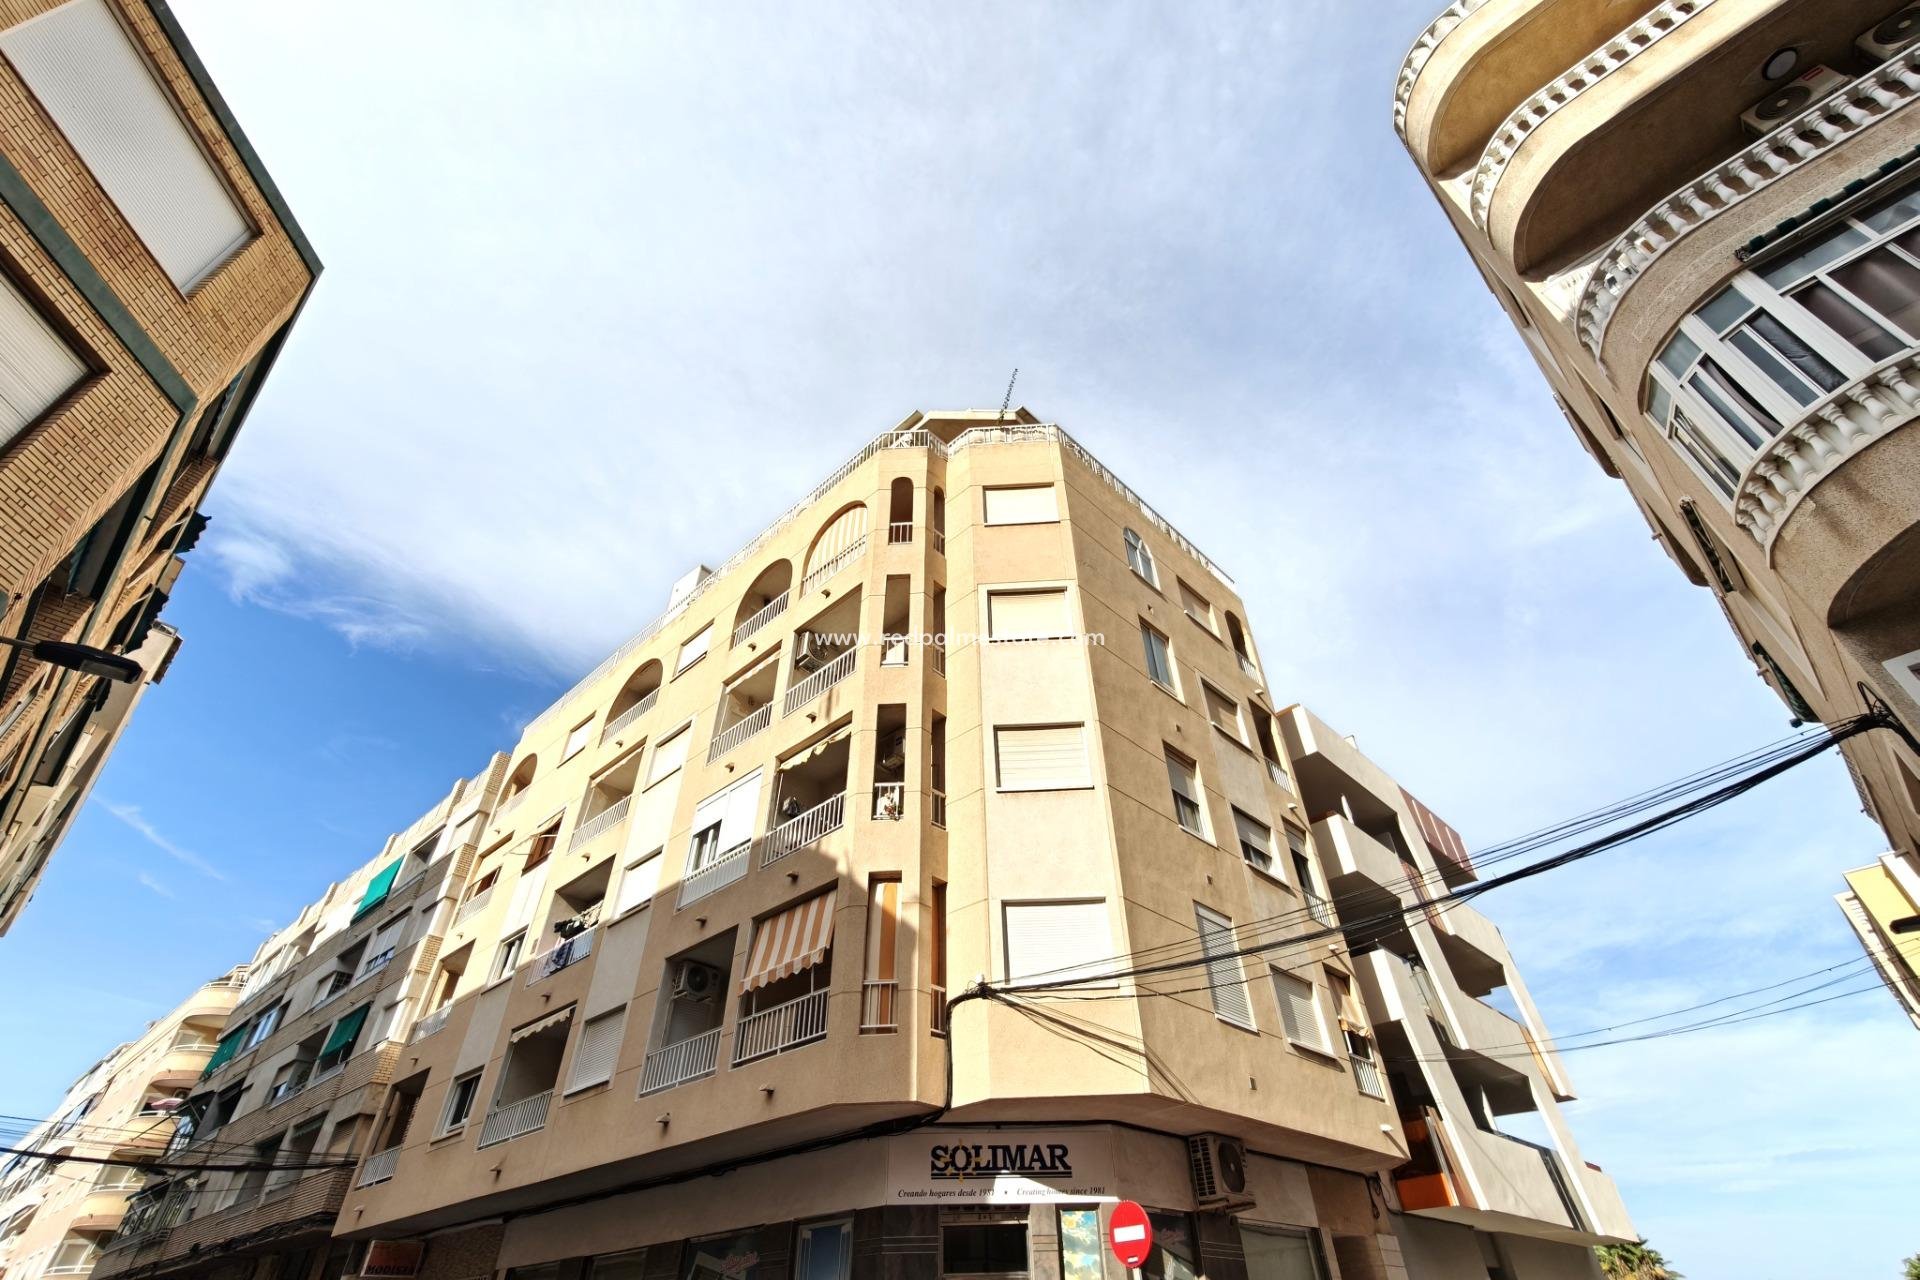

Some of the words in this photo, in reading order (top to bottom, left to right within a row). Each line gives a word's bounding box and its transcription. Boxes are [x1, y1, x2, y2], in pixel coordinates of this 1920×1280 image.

[931, 1143, 1072, 1172] SOLIMAR
[898, 1188, 927, 1198] Creando
[928, 1188, 956, 1199] hogares
[957, 1188, 977, 1197] desde
[1017, 1187, 1046, 1197] Creating
[1069, 1186, 1087, 1195] since
[1089, 1186, 1106, 1195] 1981
